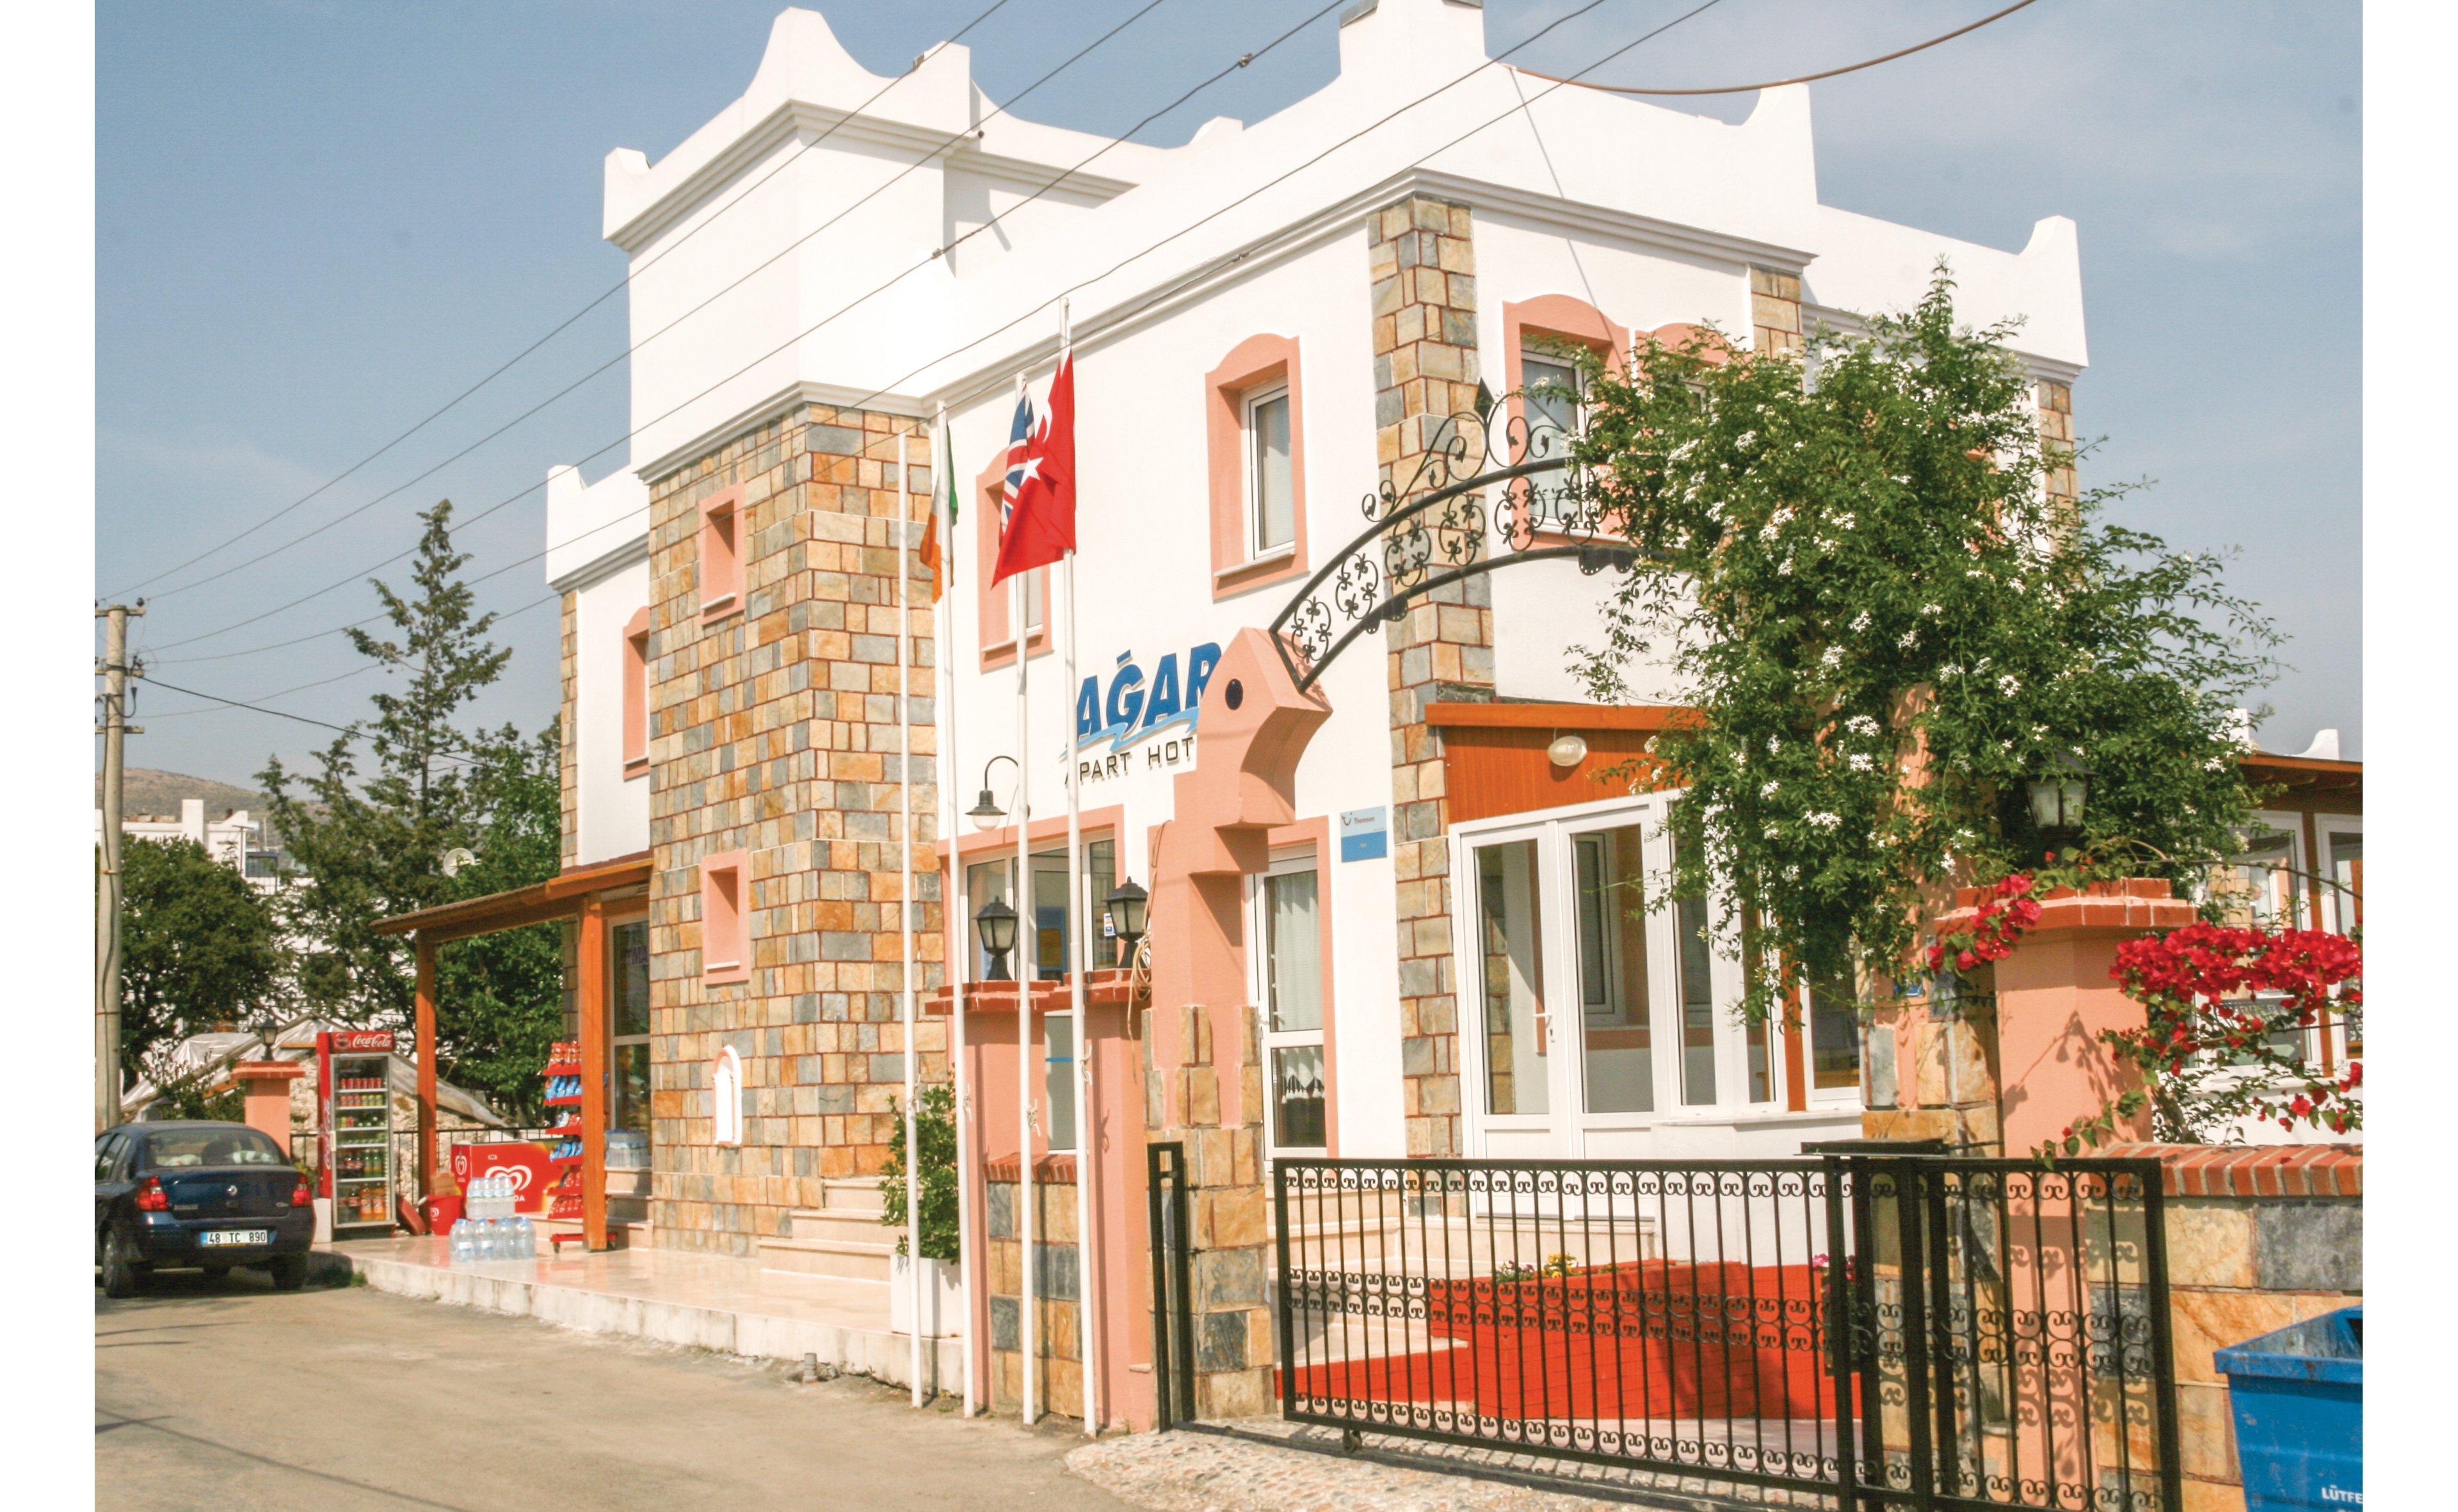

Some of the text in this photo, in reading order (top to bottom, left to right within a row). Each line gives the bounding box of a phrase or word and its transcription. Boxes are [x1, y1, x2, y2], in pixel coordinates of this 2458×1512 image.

[1065, 737, 1193, 785] PART HOT
[209, 1232, 266, 1243] 48 TC 890
[2322, 1484, 2363, 1504] LÜTFE
